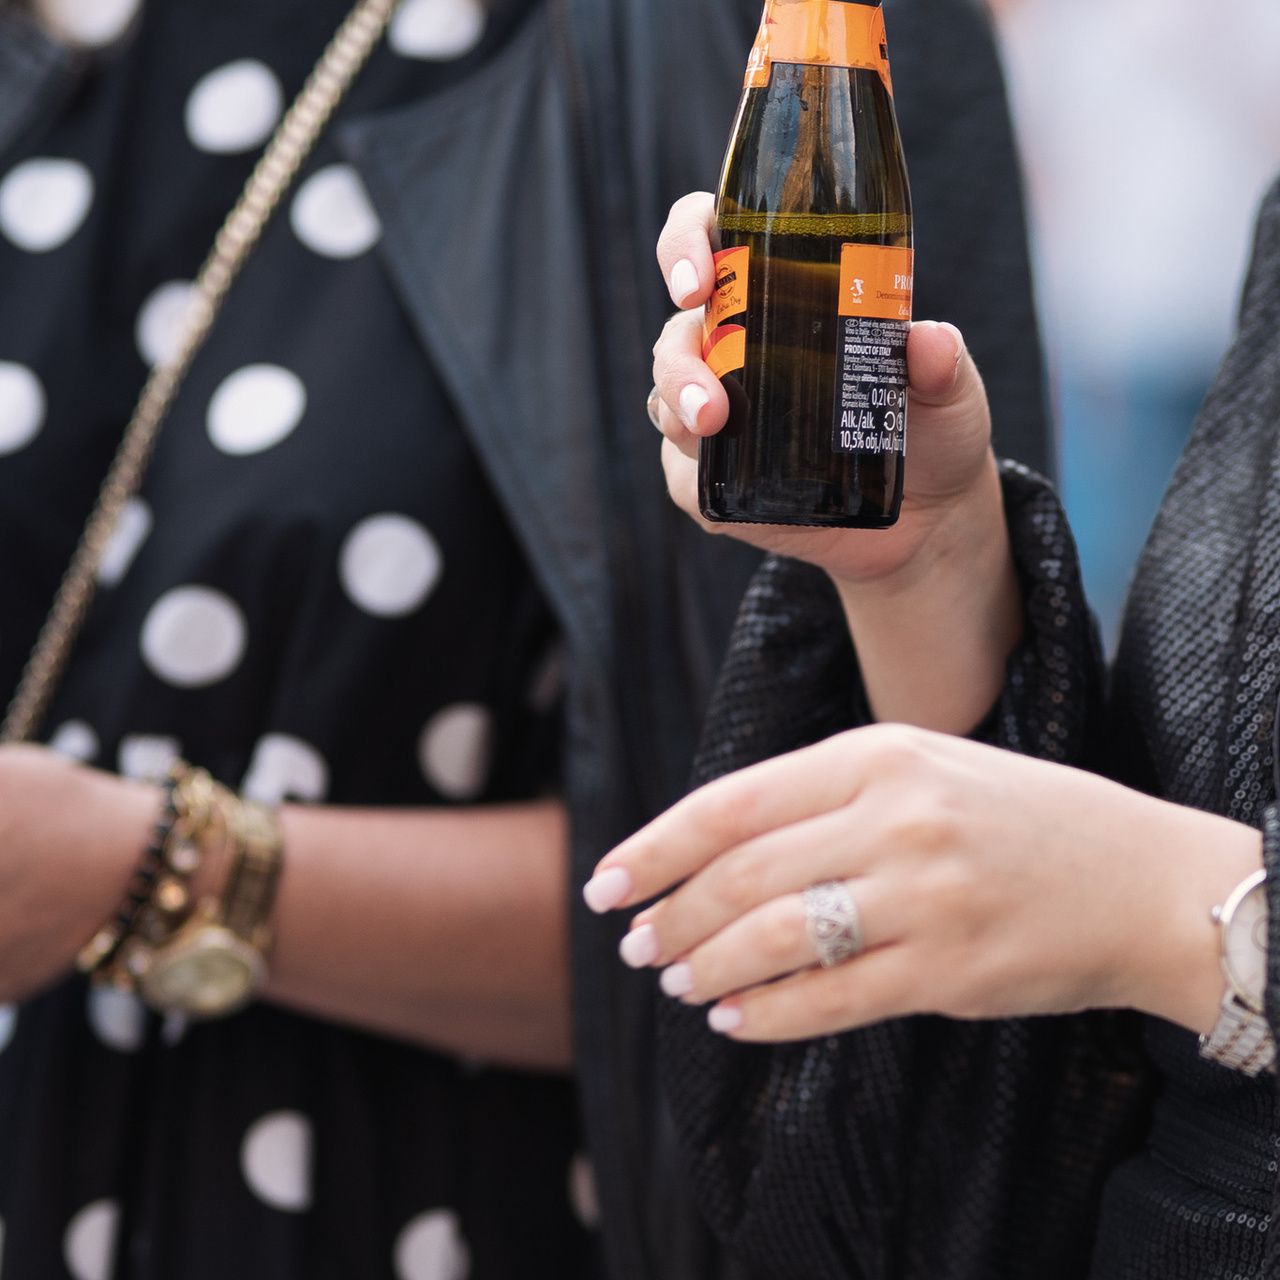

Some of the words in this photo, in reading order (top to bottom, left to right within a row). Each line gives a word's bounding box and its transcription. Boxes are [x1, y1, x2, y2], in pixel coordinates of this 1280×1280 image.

[844, 344, 871, 356] PRODUCT
[871, 346, 879, 356] OF
[878, 346, 892, 357] ITALY
[840, 430, 865, 451] 10,5%
